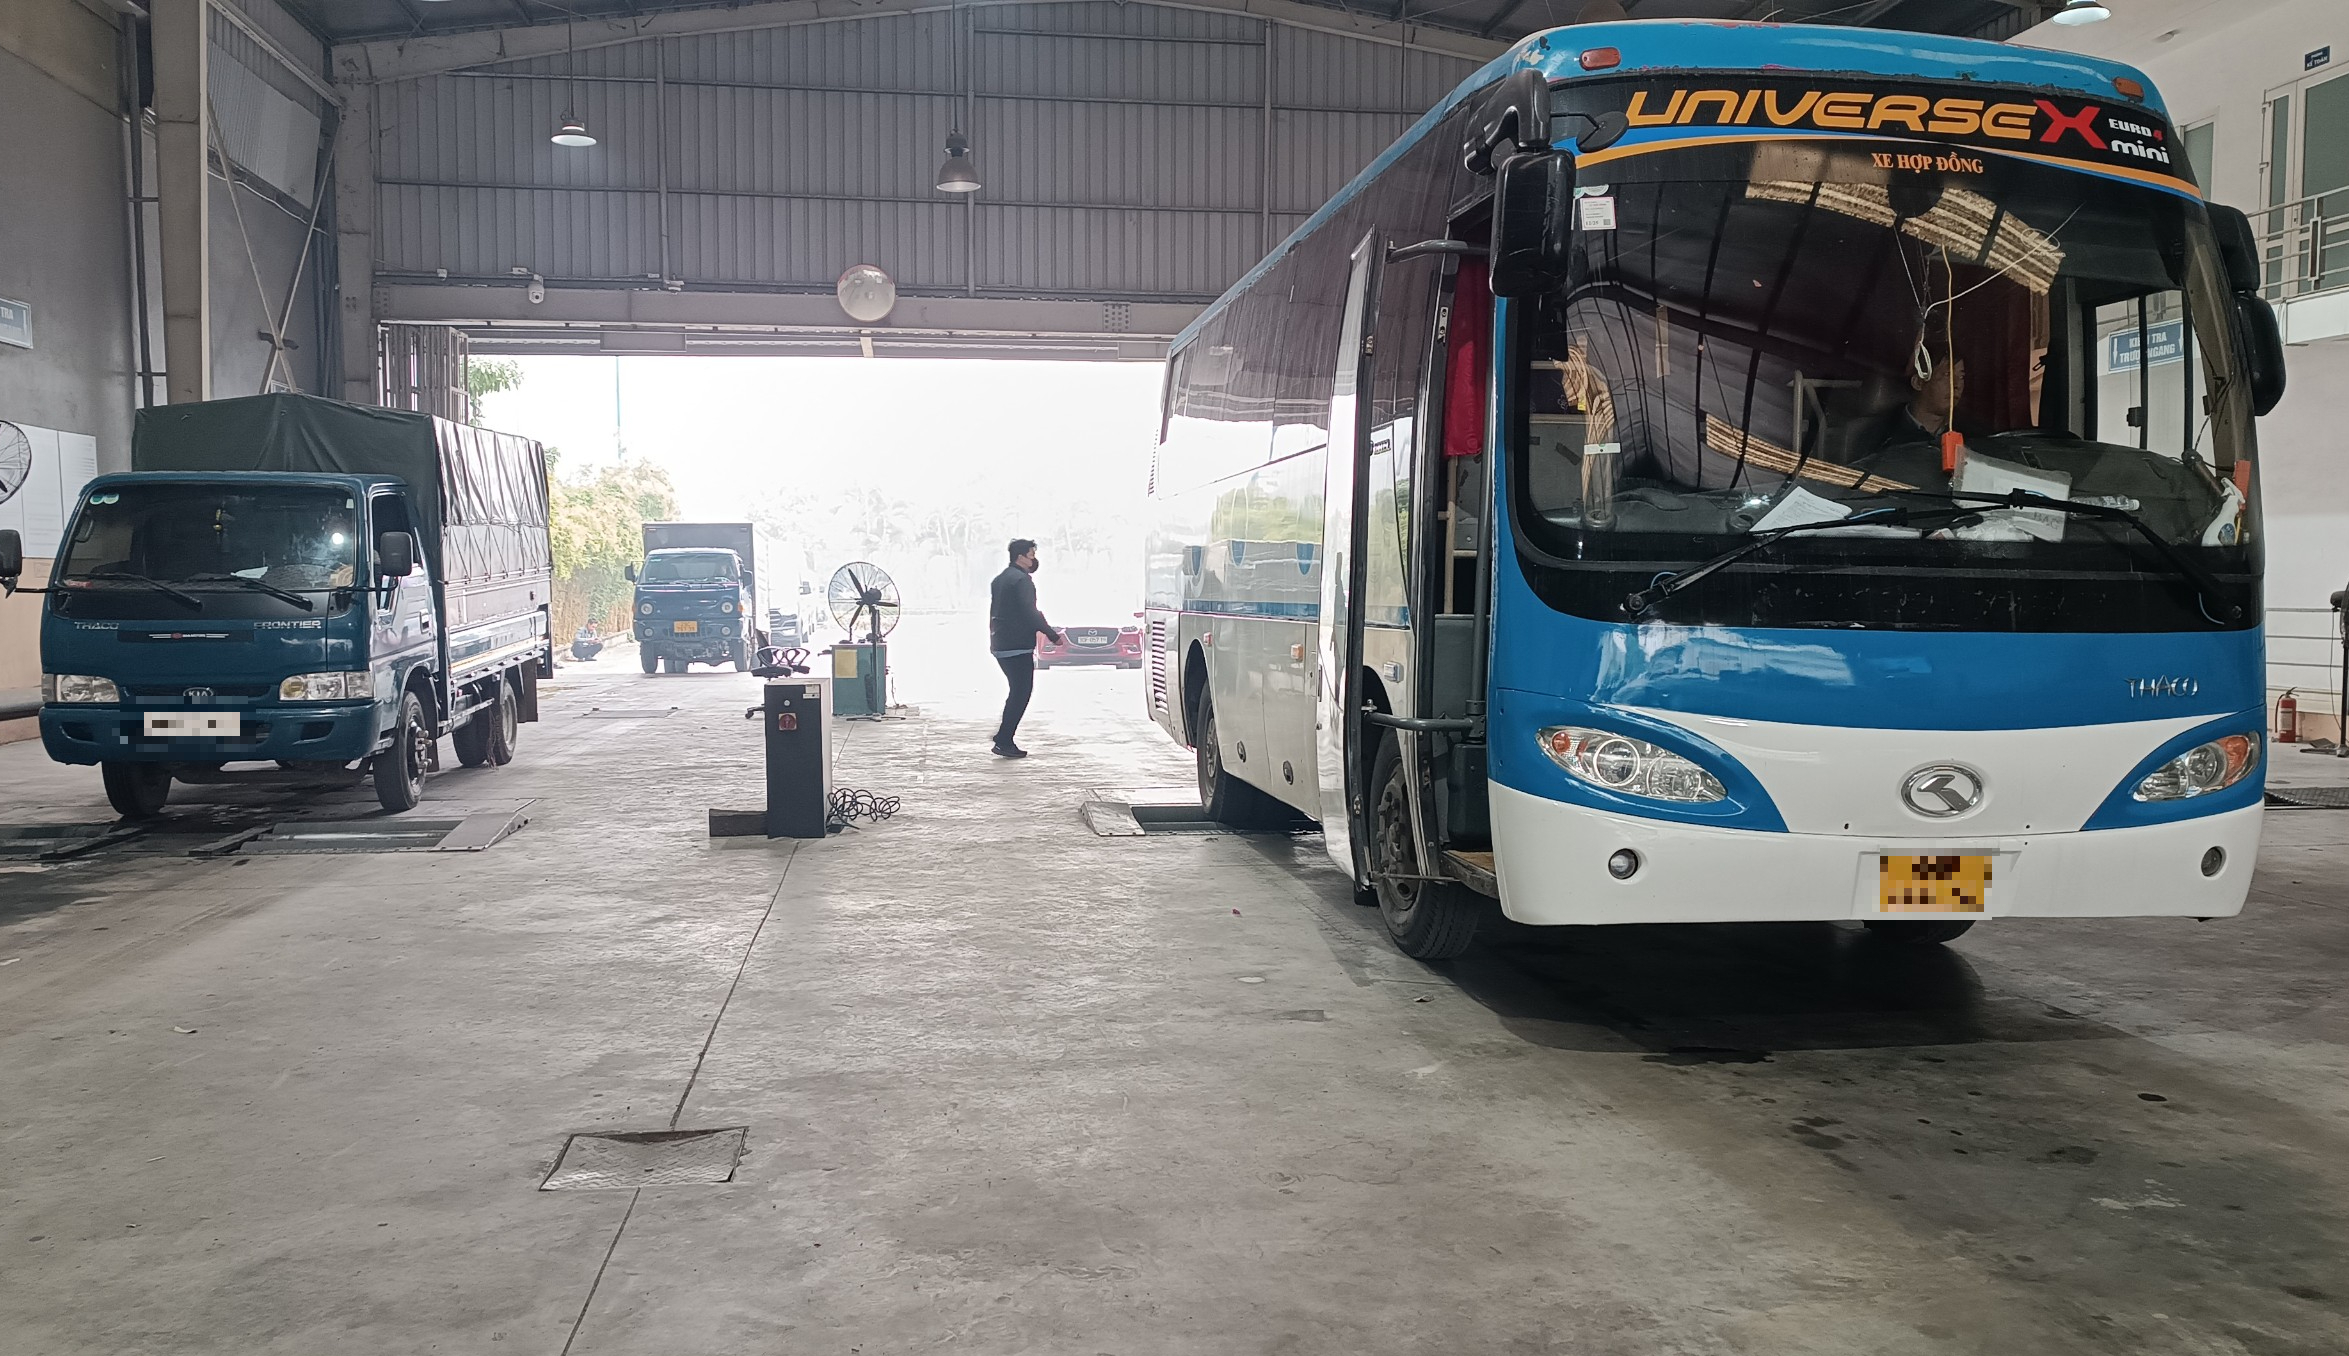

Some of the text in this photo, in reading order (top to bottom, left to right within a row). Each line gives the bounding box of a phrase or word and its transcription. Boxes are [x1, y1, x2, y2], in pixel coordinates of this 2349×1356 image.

[2111, 140, 2170, 164] mini
[1871, 151, 1984, 174] XE HỢP ĐỒNG
[2151, 331, 2167, 344] TRA
[74, 621, 119, 630] THACO
[253, 620, 322, 630] FRONTIER
[2124, 675, 2198, 698] THACO
